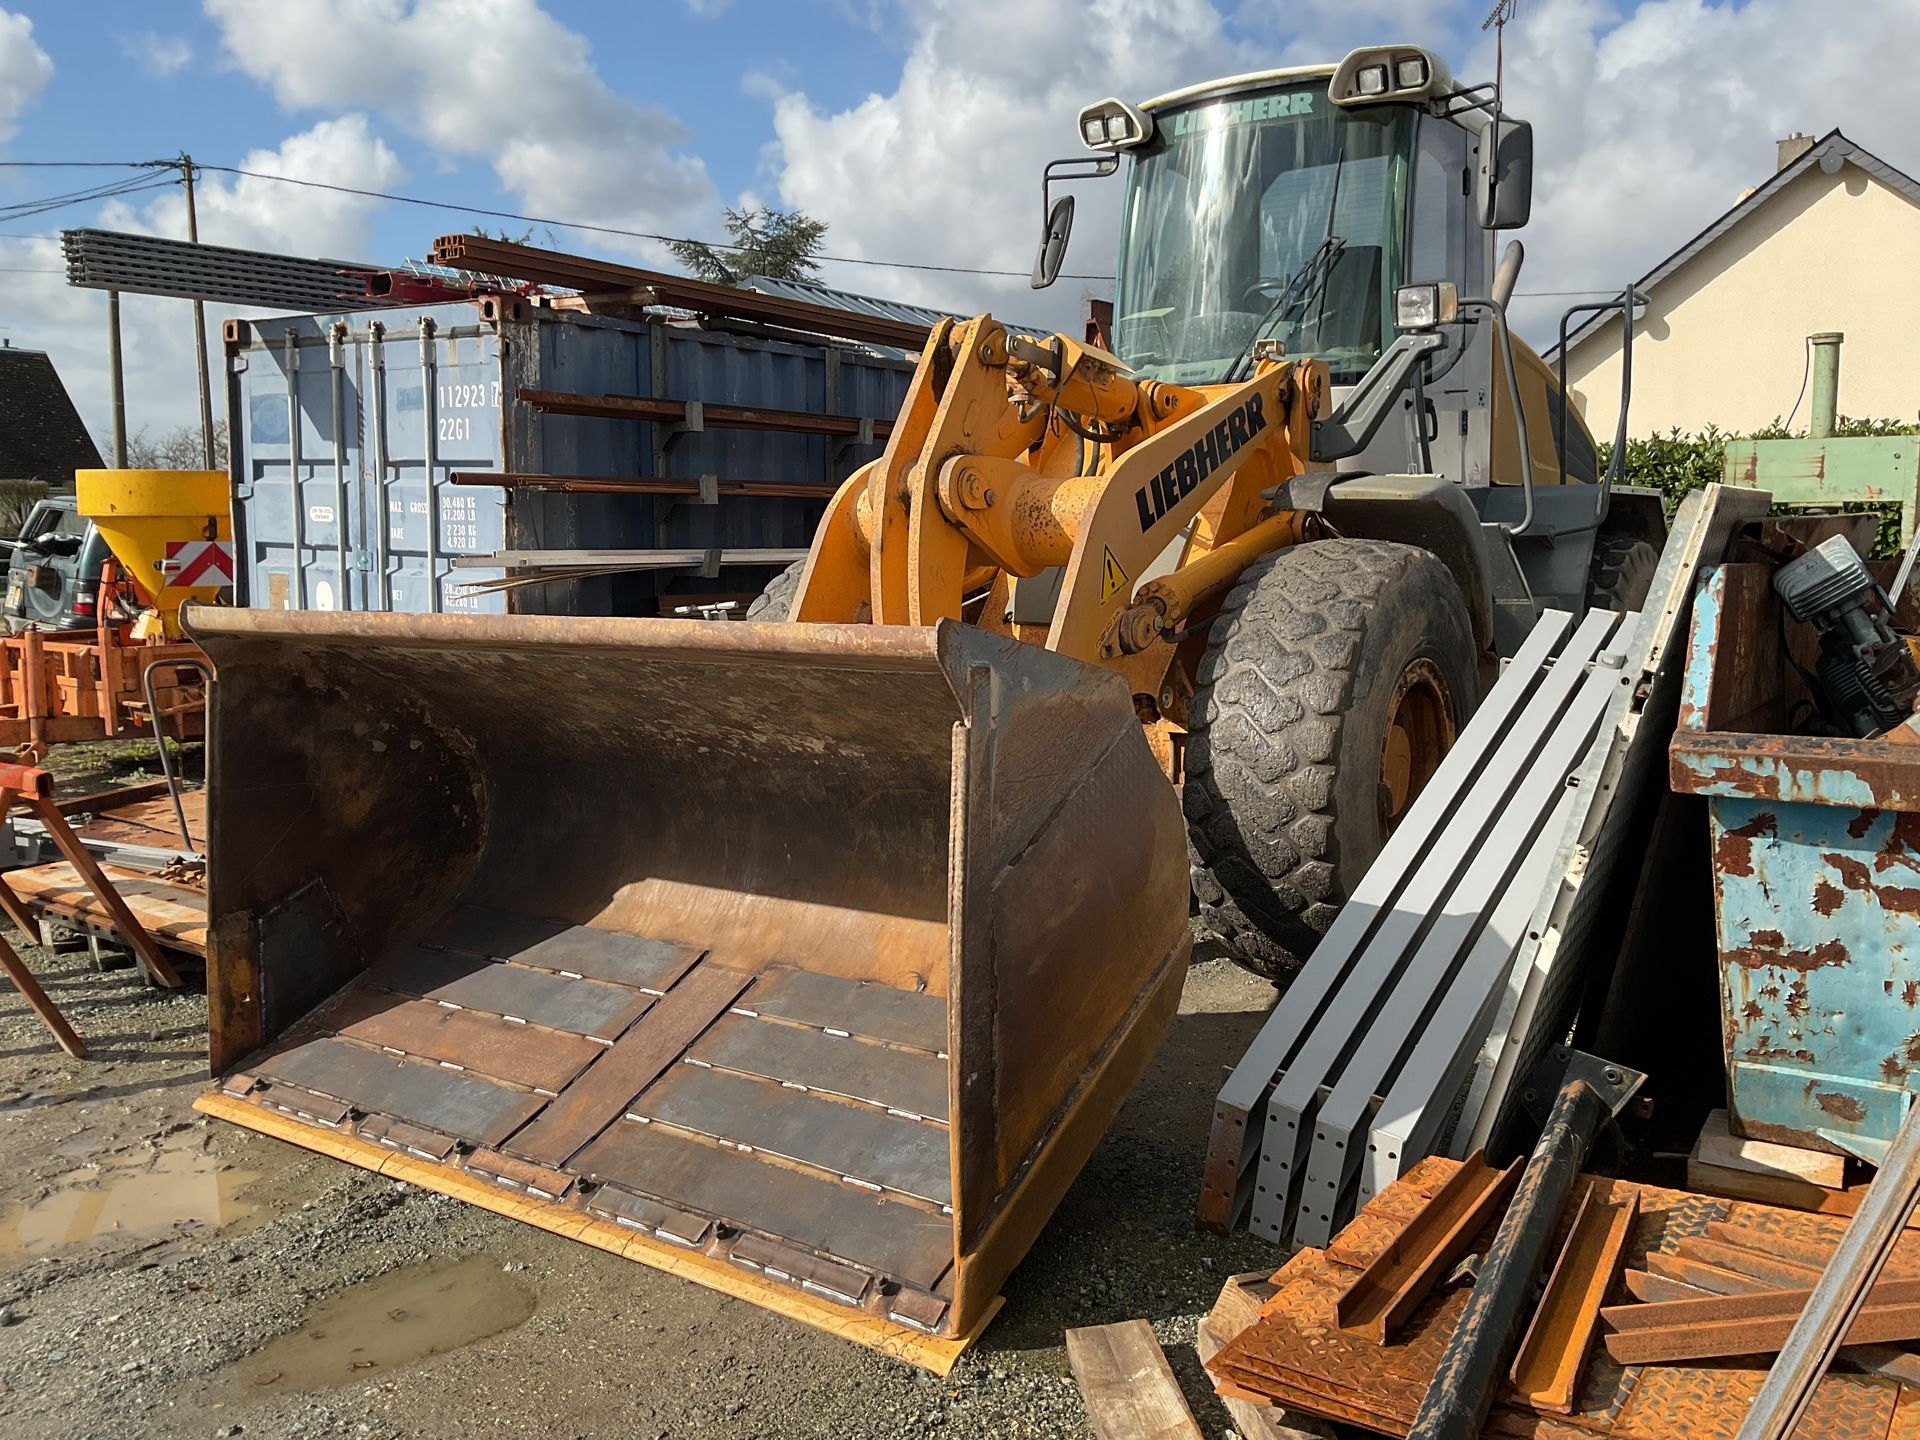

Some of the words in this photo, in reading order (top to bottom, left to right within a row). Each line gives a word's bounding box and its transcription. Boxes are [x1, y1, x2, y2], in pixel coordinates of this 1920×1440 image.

[440, 384, 485, 408] 112923
[440, 418, 470, 440] 22G1
[1135, 392, 1267, 534] LIEBHERR
[442, 496, 465, 508] 30.480
[467, 496, 476, 508] KG
[443, 509, 465, 521] 67.200
[467, 509, 476, 521] LB
[390, 527, 404, 539] TARE
[468, 524, 477, 536] KG
[447, 537, 466, 548] 4.920
[468, 537, 477, 549] LB
[470, 597, 478, 608] LB
